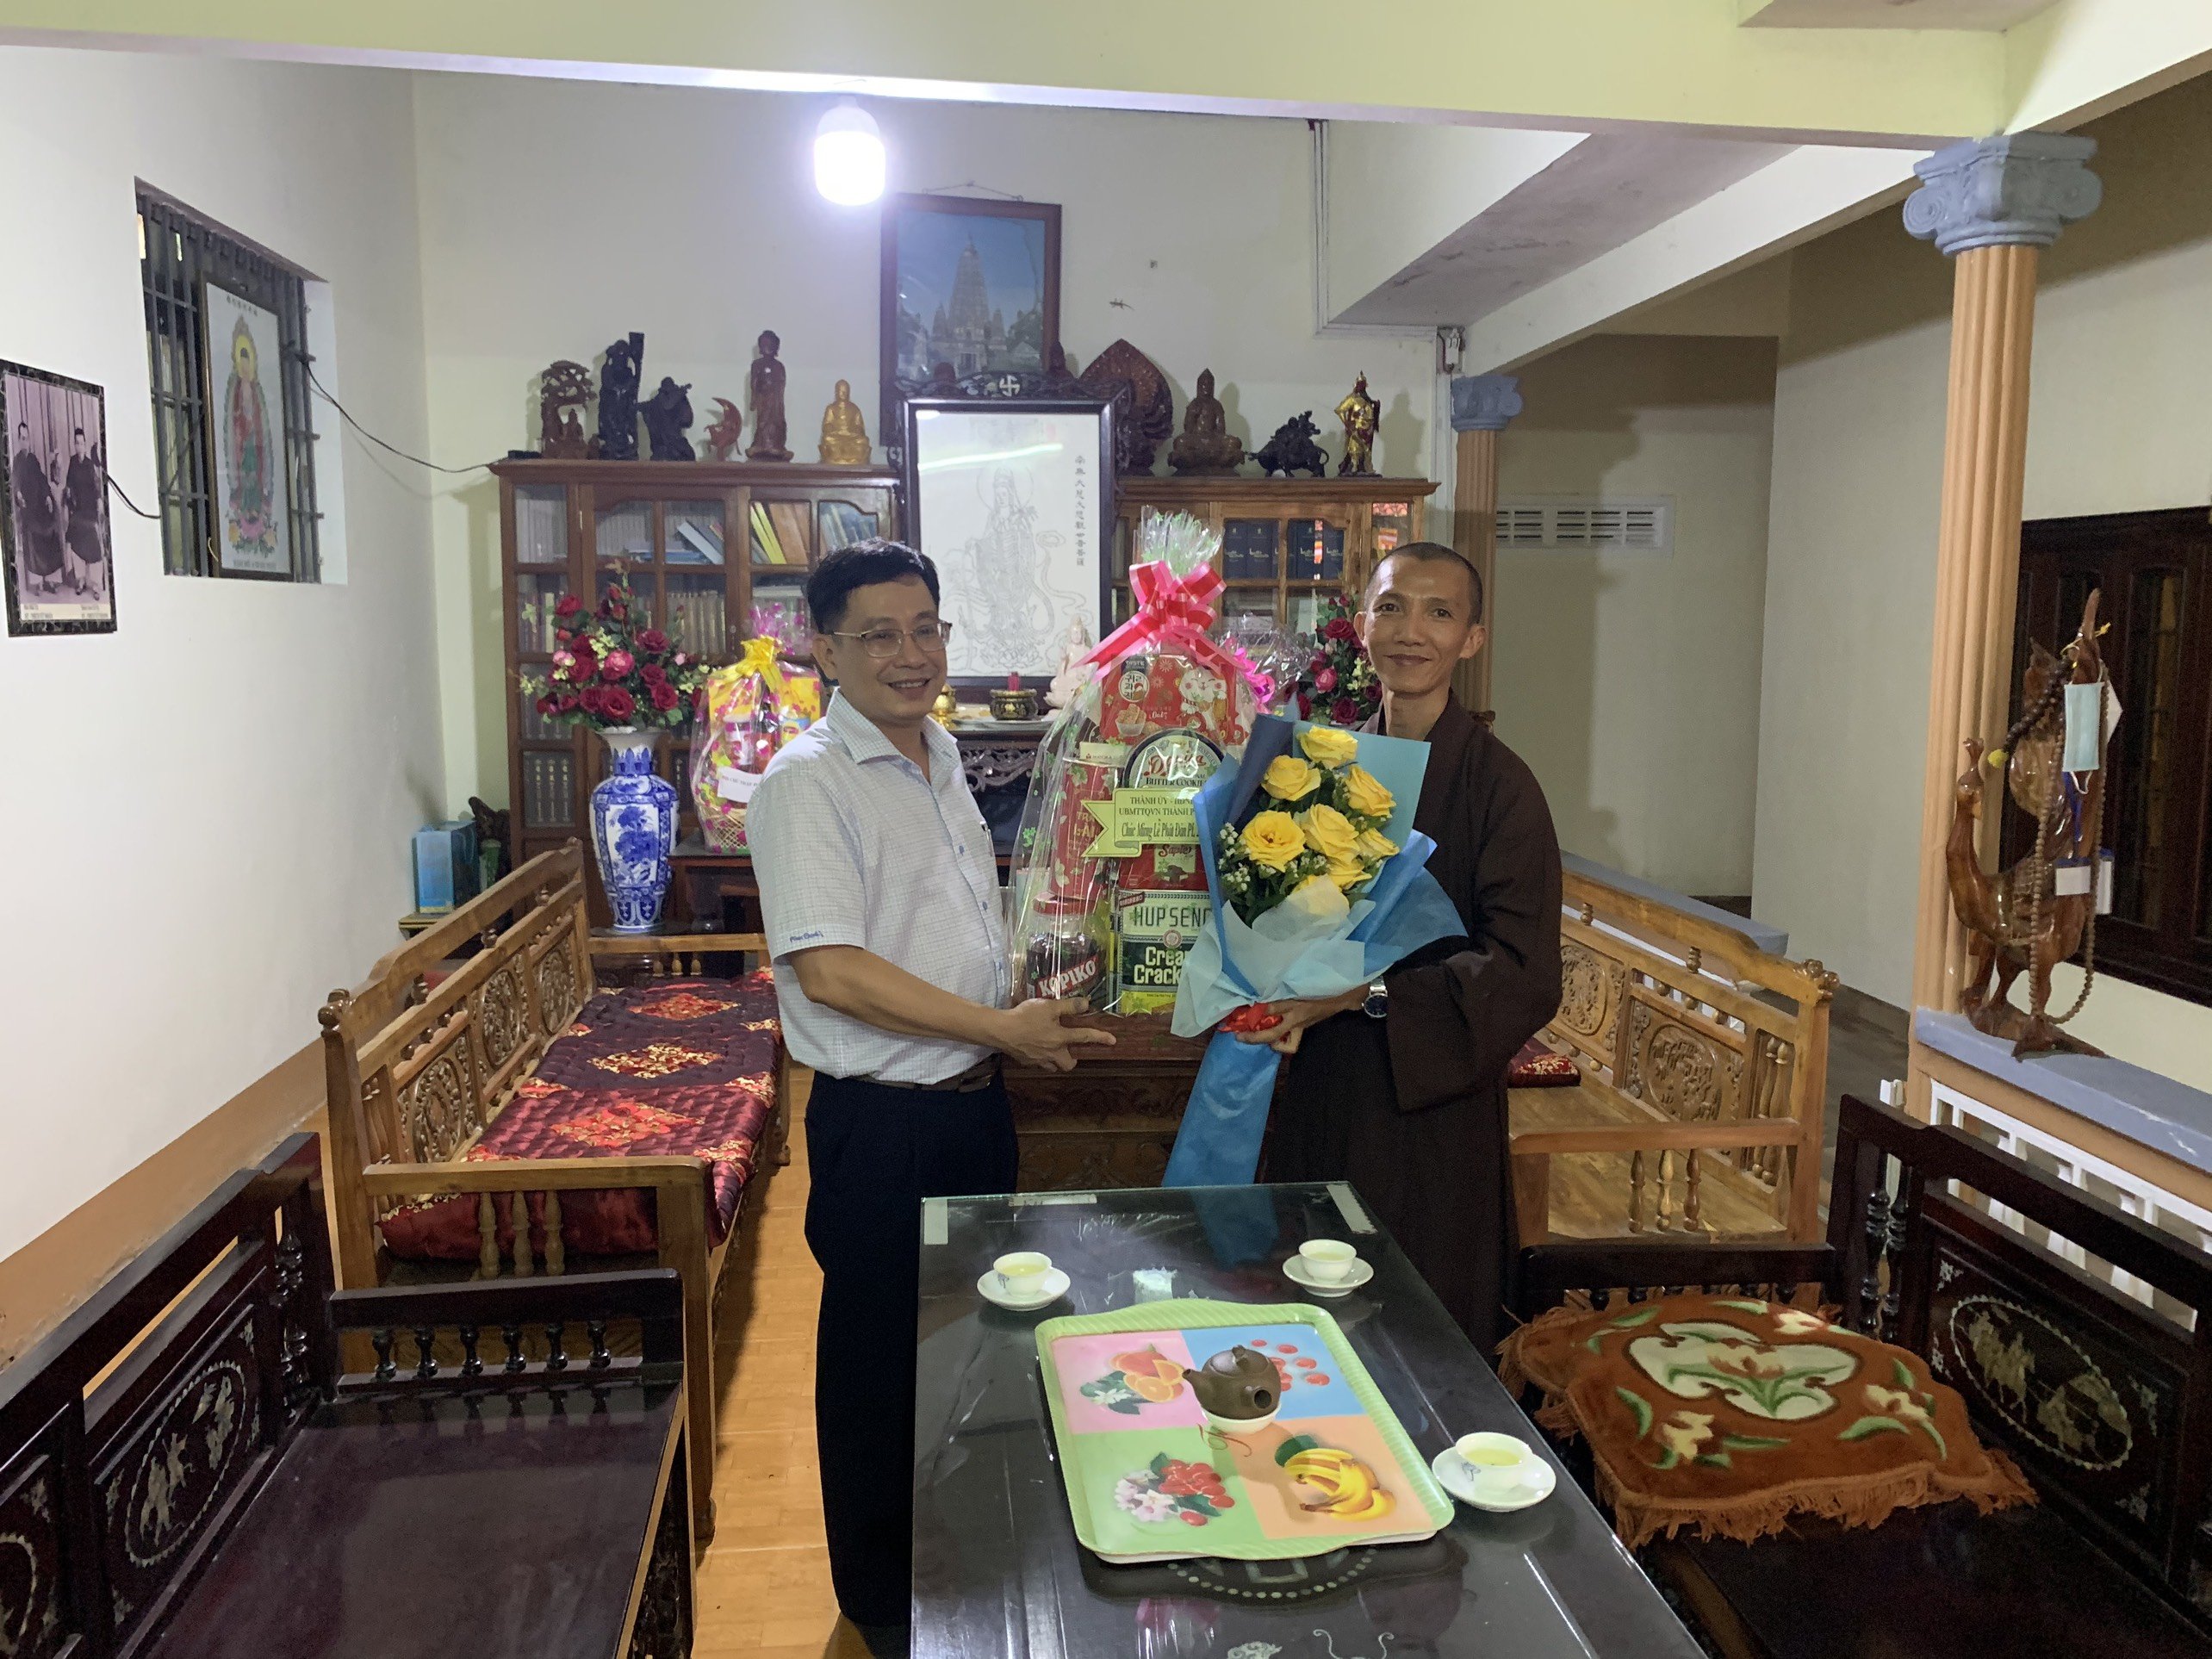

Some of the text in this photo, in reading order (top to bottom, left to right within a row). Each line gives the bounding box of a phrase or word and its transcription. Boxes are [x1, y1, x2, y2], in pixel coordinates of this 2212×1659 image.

[1177, 778, 1205, 786] COOKIE
[1130, 794, 1157, 805] THÀNH
[1119, 807, 1161, 816] UBMTTQVN
[1162, 805, 1189, 816] THÀNH
[1134, 906, 1165, 928] HUP
[1145, 946, 1190, 966] Crea
[1038, 960, 1097, 997] KOPIKO
[1134, 964, 1181, 985] Crack
